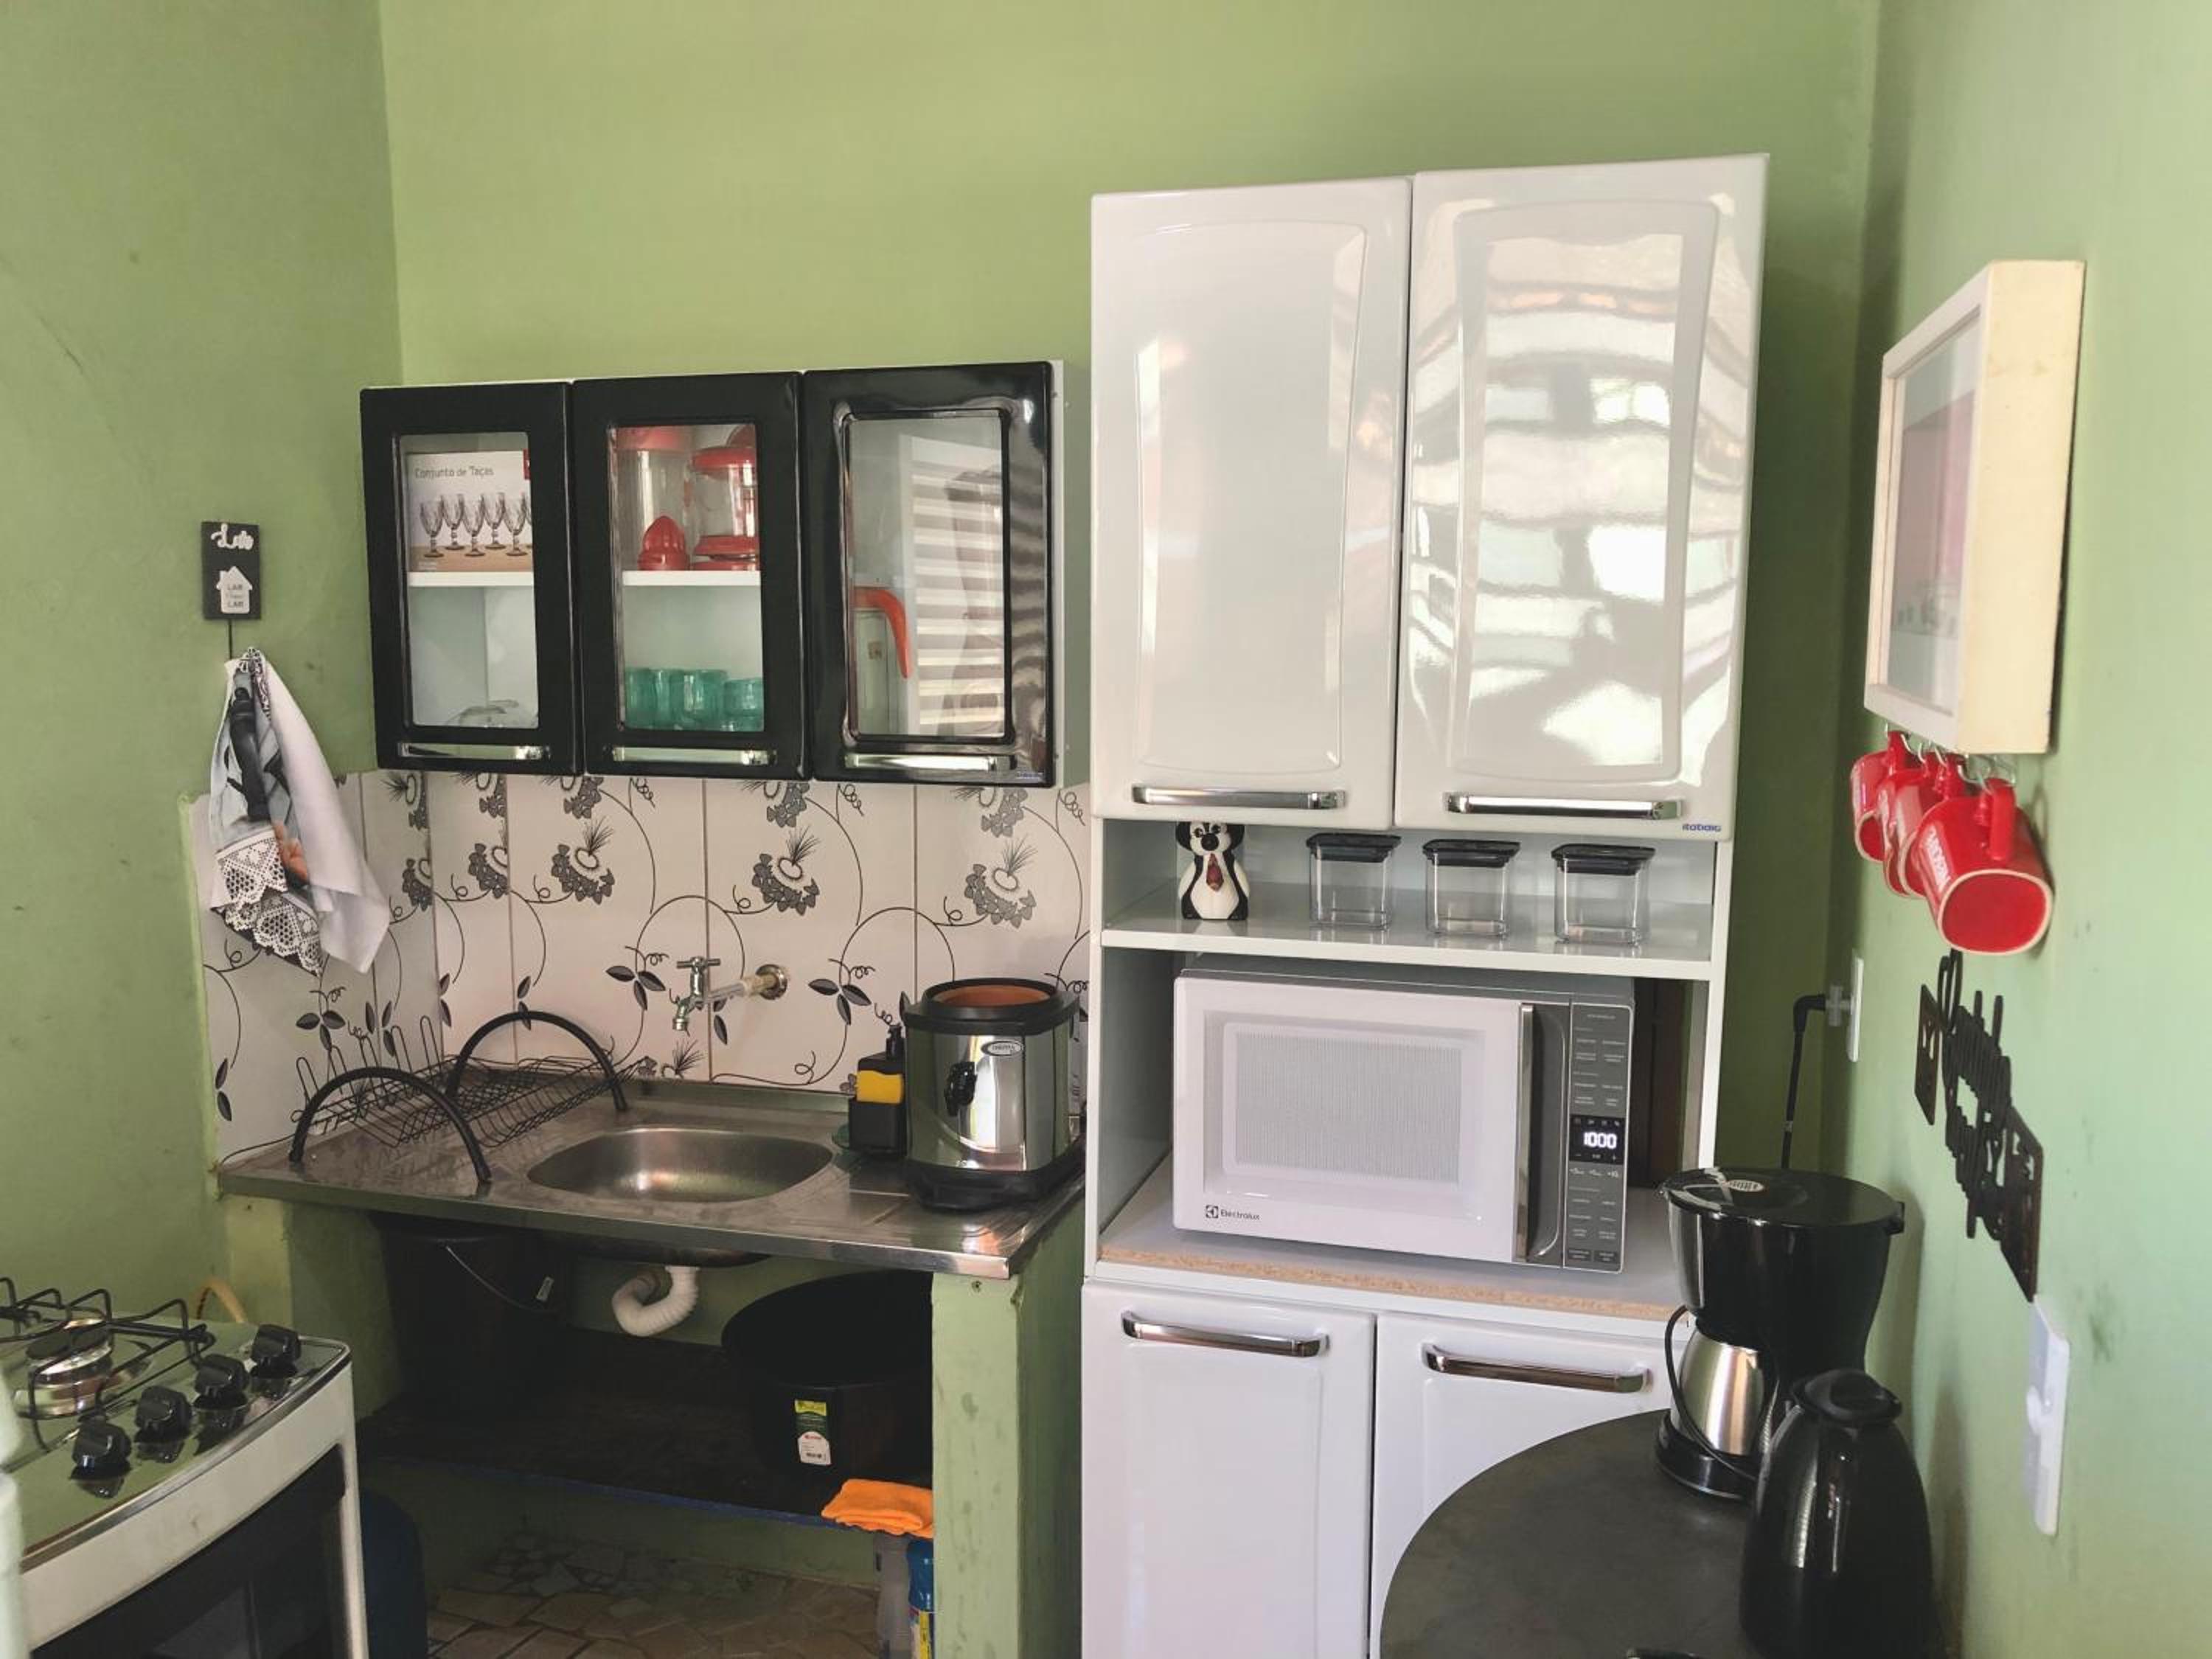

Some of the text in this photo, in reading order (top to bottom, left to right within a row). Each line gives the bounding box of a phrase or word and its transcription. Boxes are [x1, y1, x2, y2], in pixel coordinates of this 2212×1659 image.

[415, 466, 494, 479] Conjunto de Taças
[1220, 1209, 1260, 1220] Electrolux
